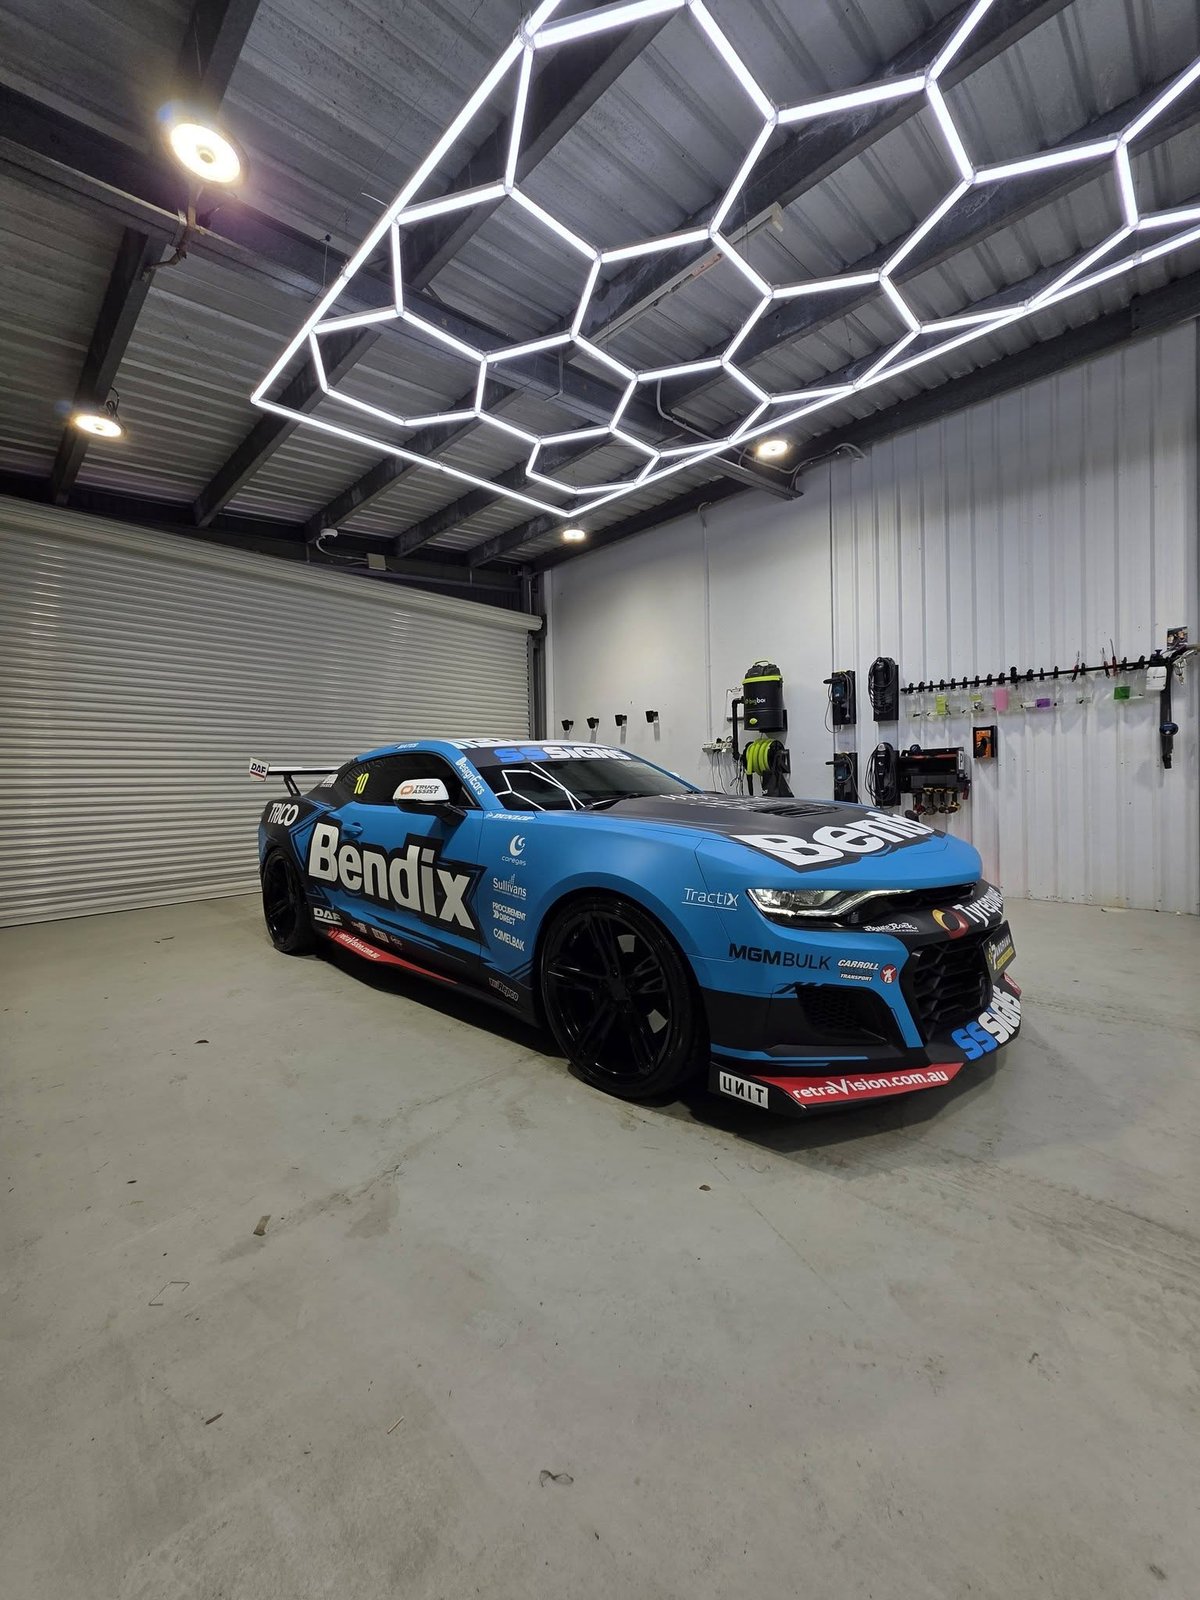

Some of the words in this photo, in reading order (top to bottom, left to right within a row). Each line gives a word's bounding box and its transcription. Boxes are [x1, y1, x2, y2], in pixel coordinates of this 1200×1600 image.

[250, 763, 266, 774] DAF
[353, 772, 370, 796] 10
[267, 802, 299, 827] TRICO
[492, 813, 535, 821] DUNLOP
[501, 855, 527, 866] coregas
[308, 822, 476, 930] Bendix
[493, 877, 527, 898] Sullivans
[313, 907, 341, 920] DAF
[492, 901, 527, 922] PROCUREMENT
[499, 914, 516, 926] DIRECT
[493, 927, 525, 952] CAMELBAK
[837, 959, 879, 971] CARROLL
[840, 973, 873, 982] TRANSPORT
[793, 1069, 949, 1099] retraVision.com.au
